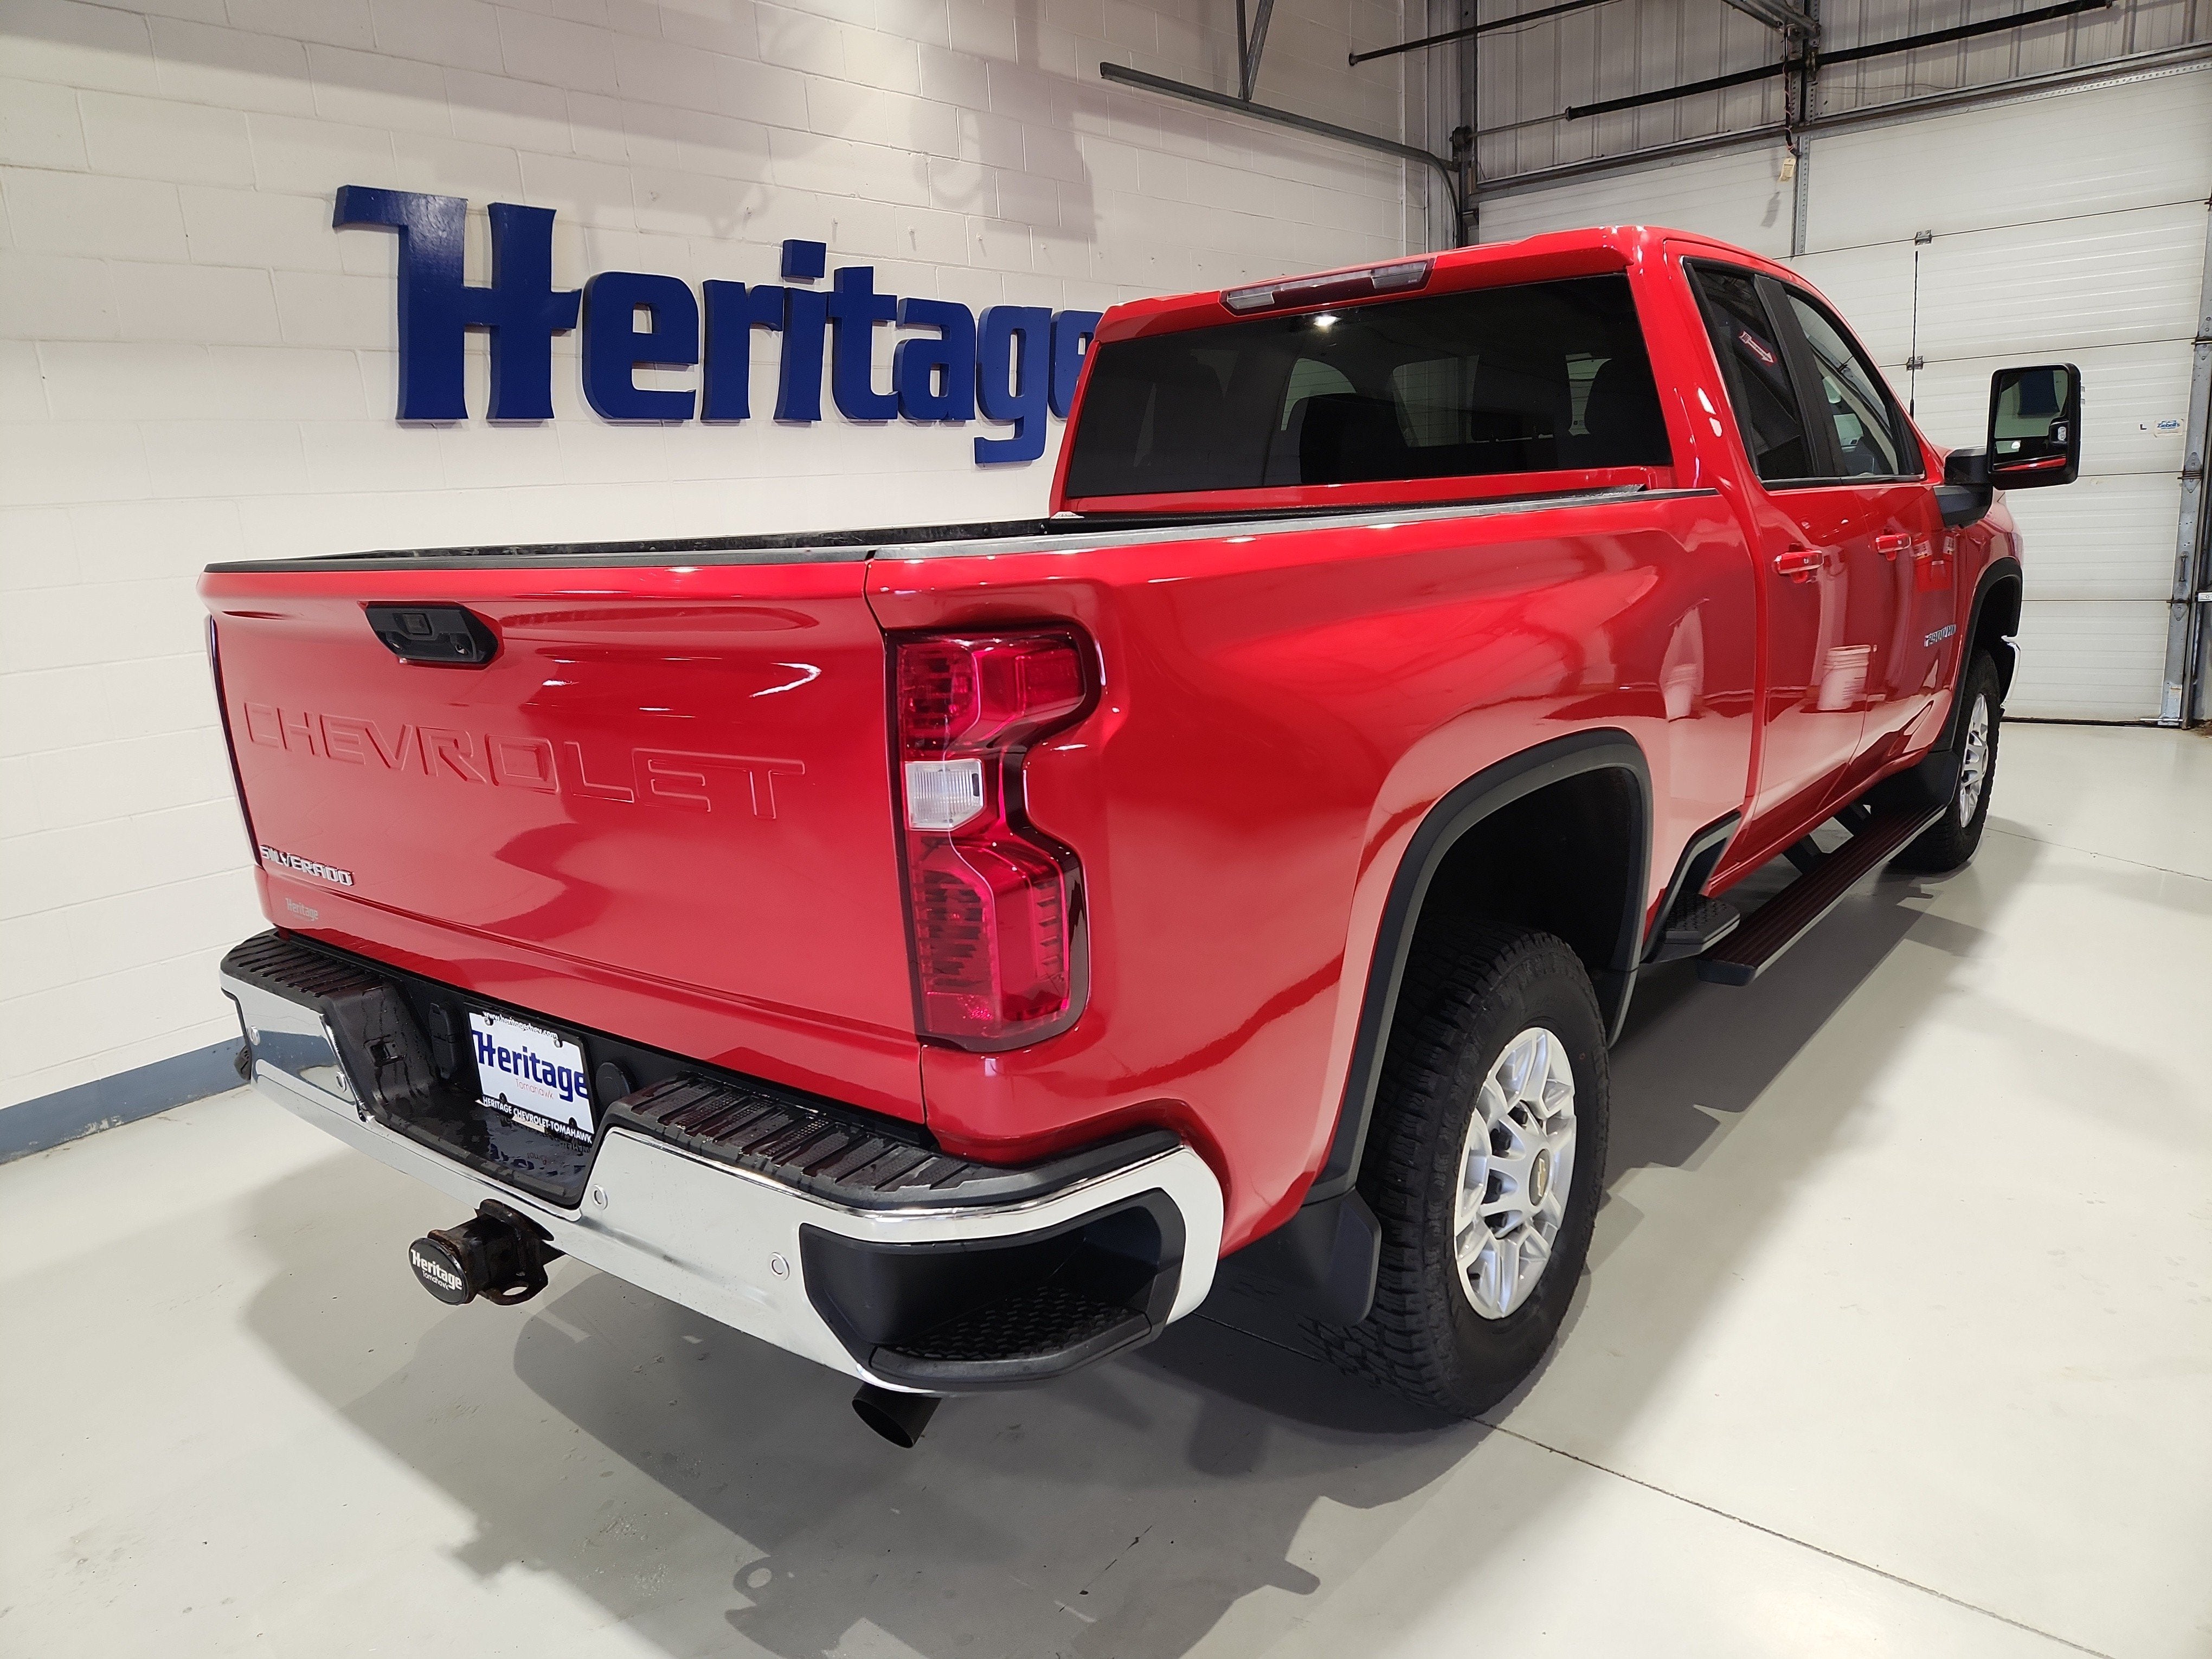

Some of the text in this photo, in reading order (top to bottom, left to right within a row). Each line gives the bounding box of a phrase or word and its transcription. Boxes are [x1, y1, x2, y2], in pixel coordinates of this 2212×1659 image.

[245, 702, 805, 819] CHEVROLET
[259, 844, 354, 886] SILVERADO
[285, 898, 319, 921] Heritage
[483, 1011, 558, 1039] www.heritagechev.com
[472, 1030, 589, 1102] Heritage
[515, 1078, 554, 1099] Tomahawk
[483, 1096, 593, 1144] HERITAGE CHEVROLET-TOMAHAWK
[410, 1249, 462, 1290] Heritage
[422, 1270, 449, 1290] Tomahawk
